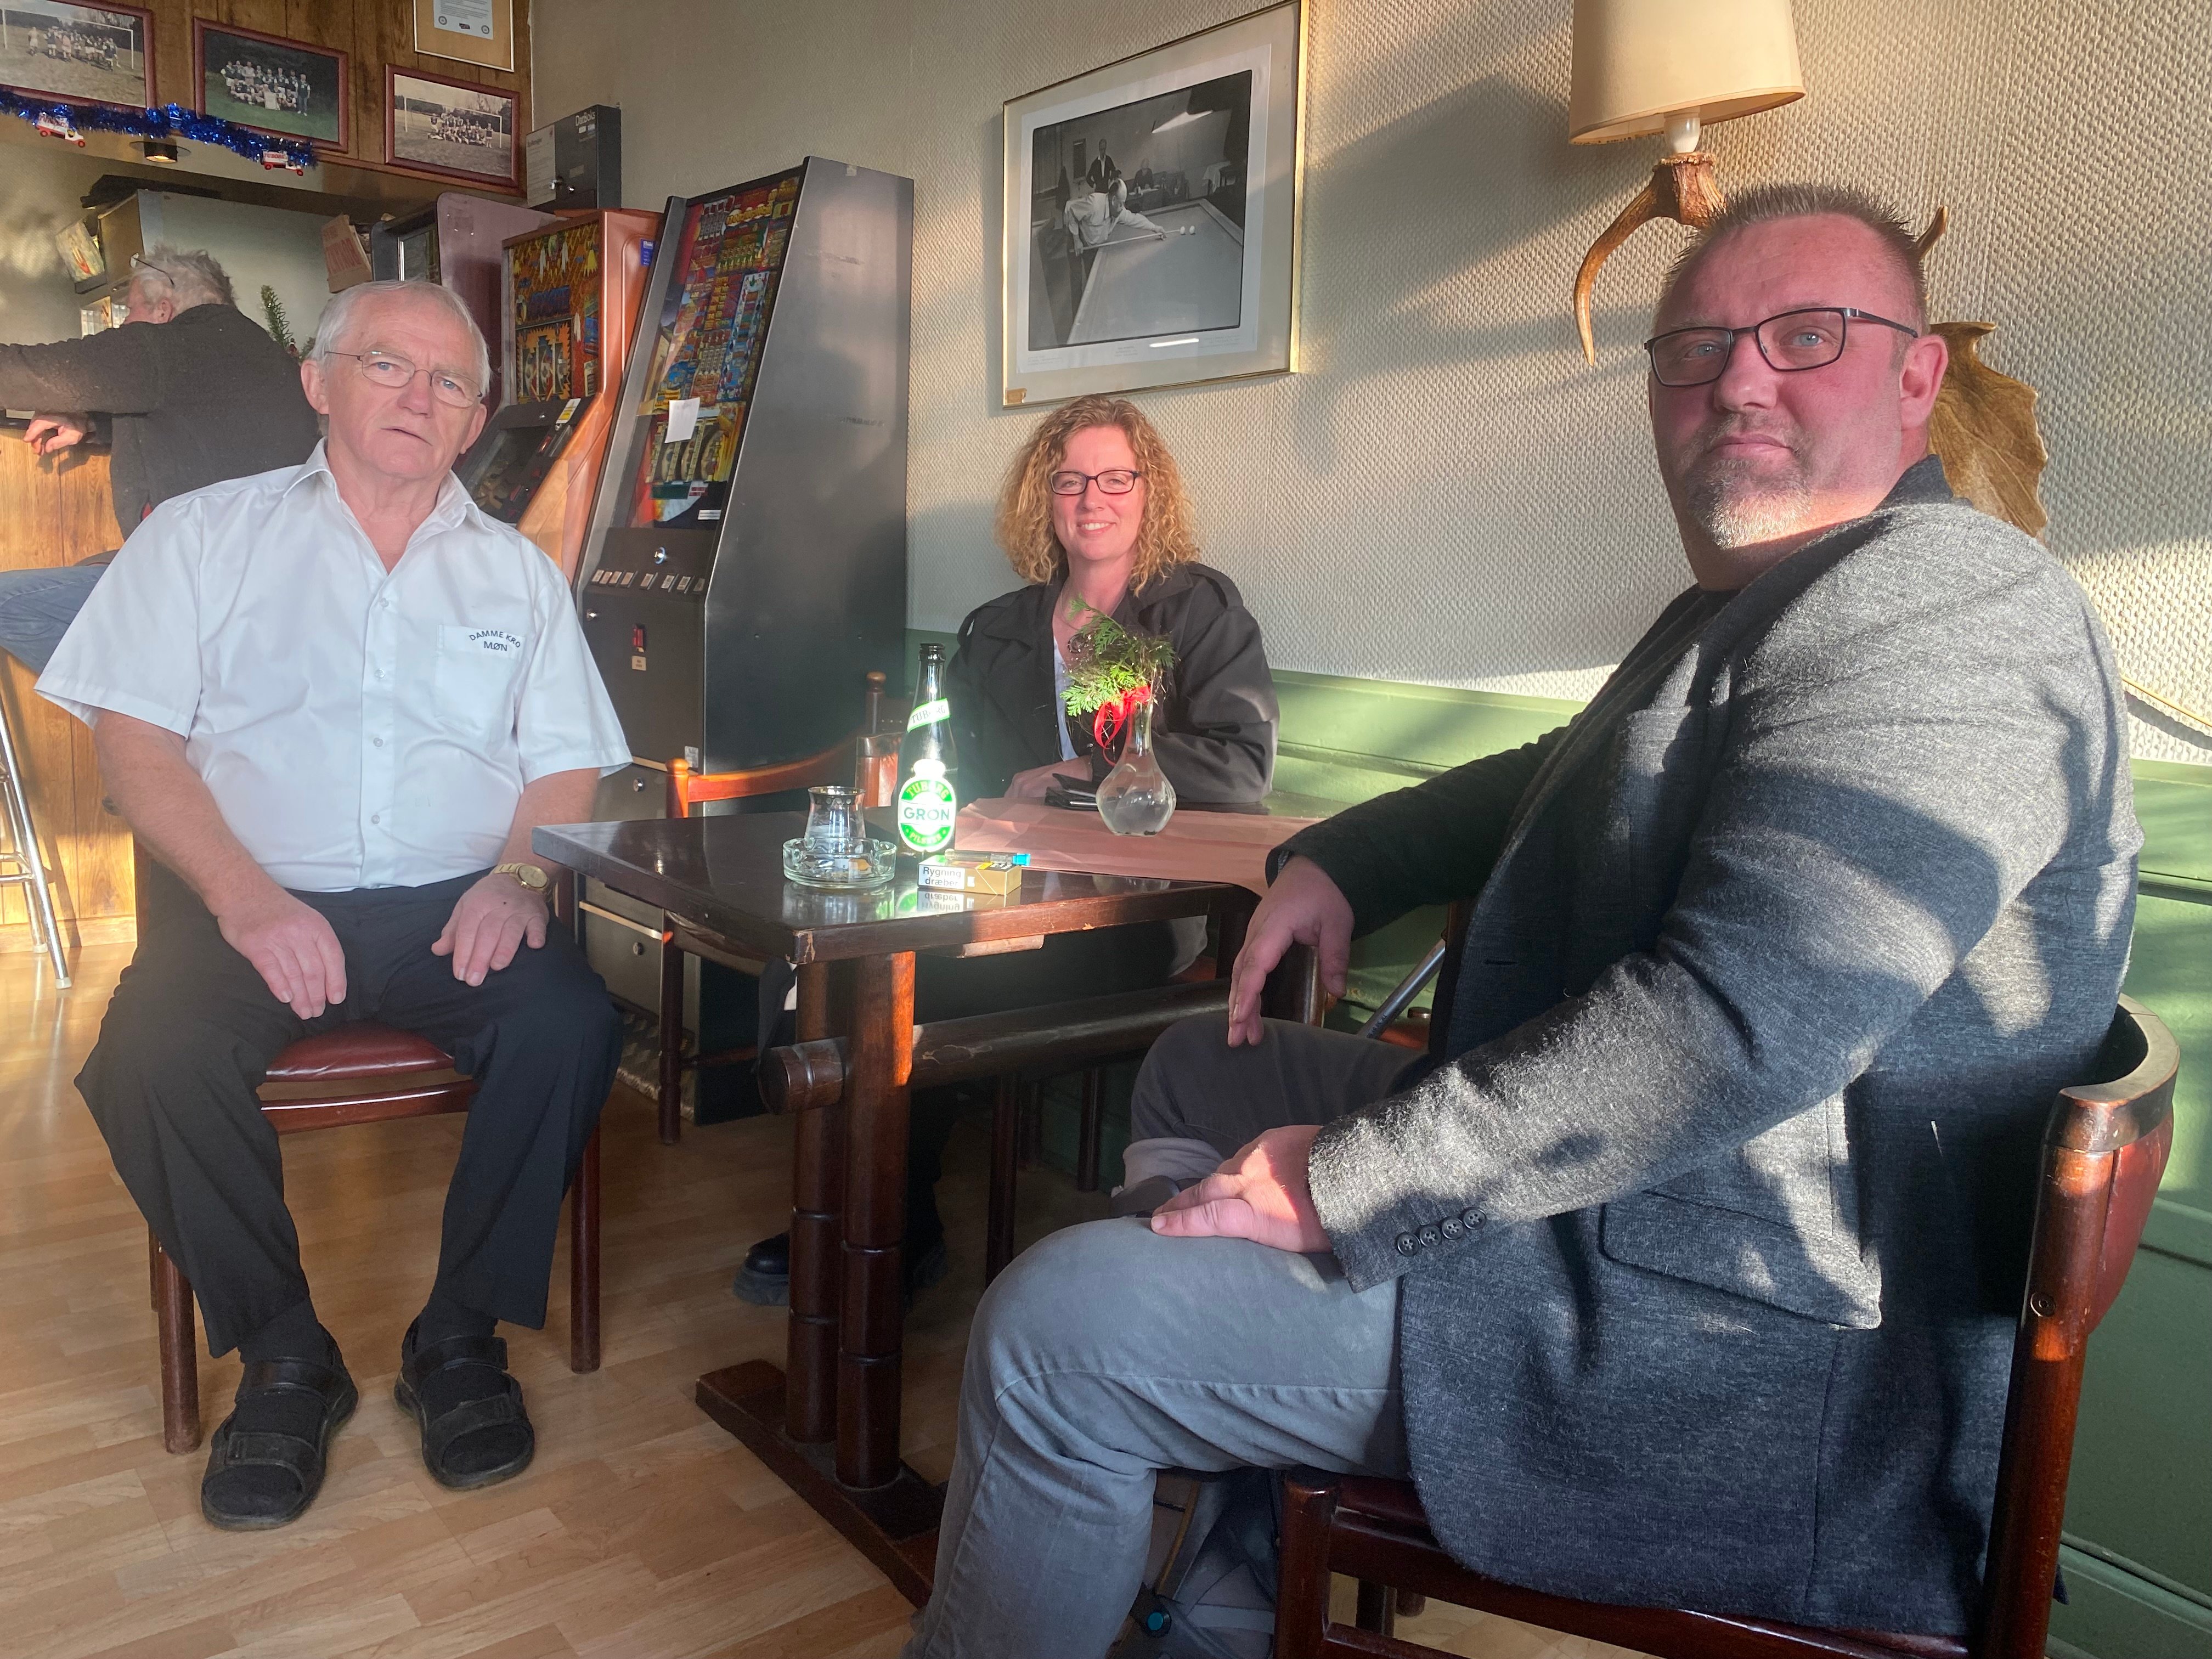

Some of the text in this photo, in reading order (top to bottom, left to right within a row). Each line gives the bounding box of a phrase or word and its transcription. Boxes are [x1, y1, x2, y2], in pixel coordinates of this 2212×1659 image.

[469, 630, 521, 648] DAMME KRO
[483, 641, 507, 651] MØN
[911, 705, 946, 724] TUBRG
[906, 782, 950, 800] TUBRG
[923, 866, 961, 877] Rygning
[925, 877, 958, 886] dræber
